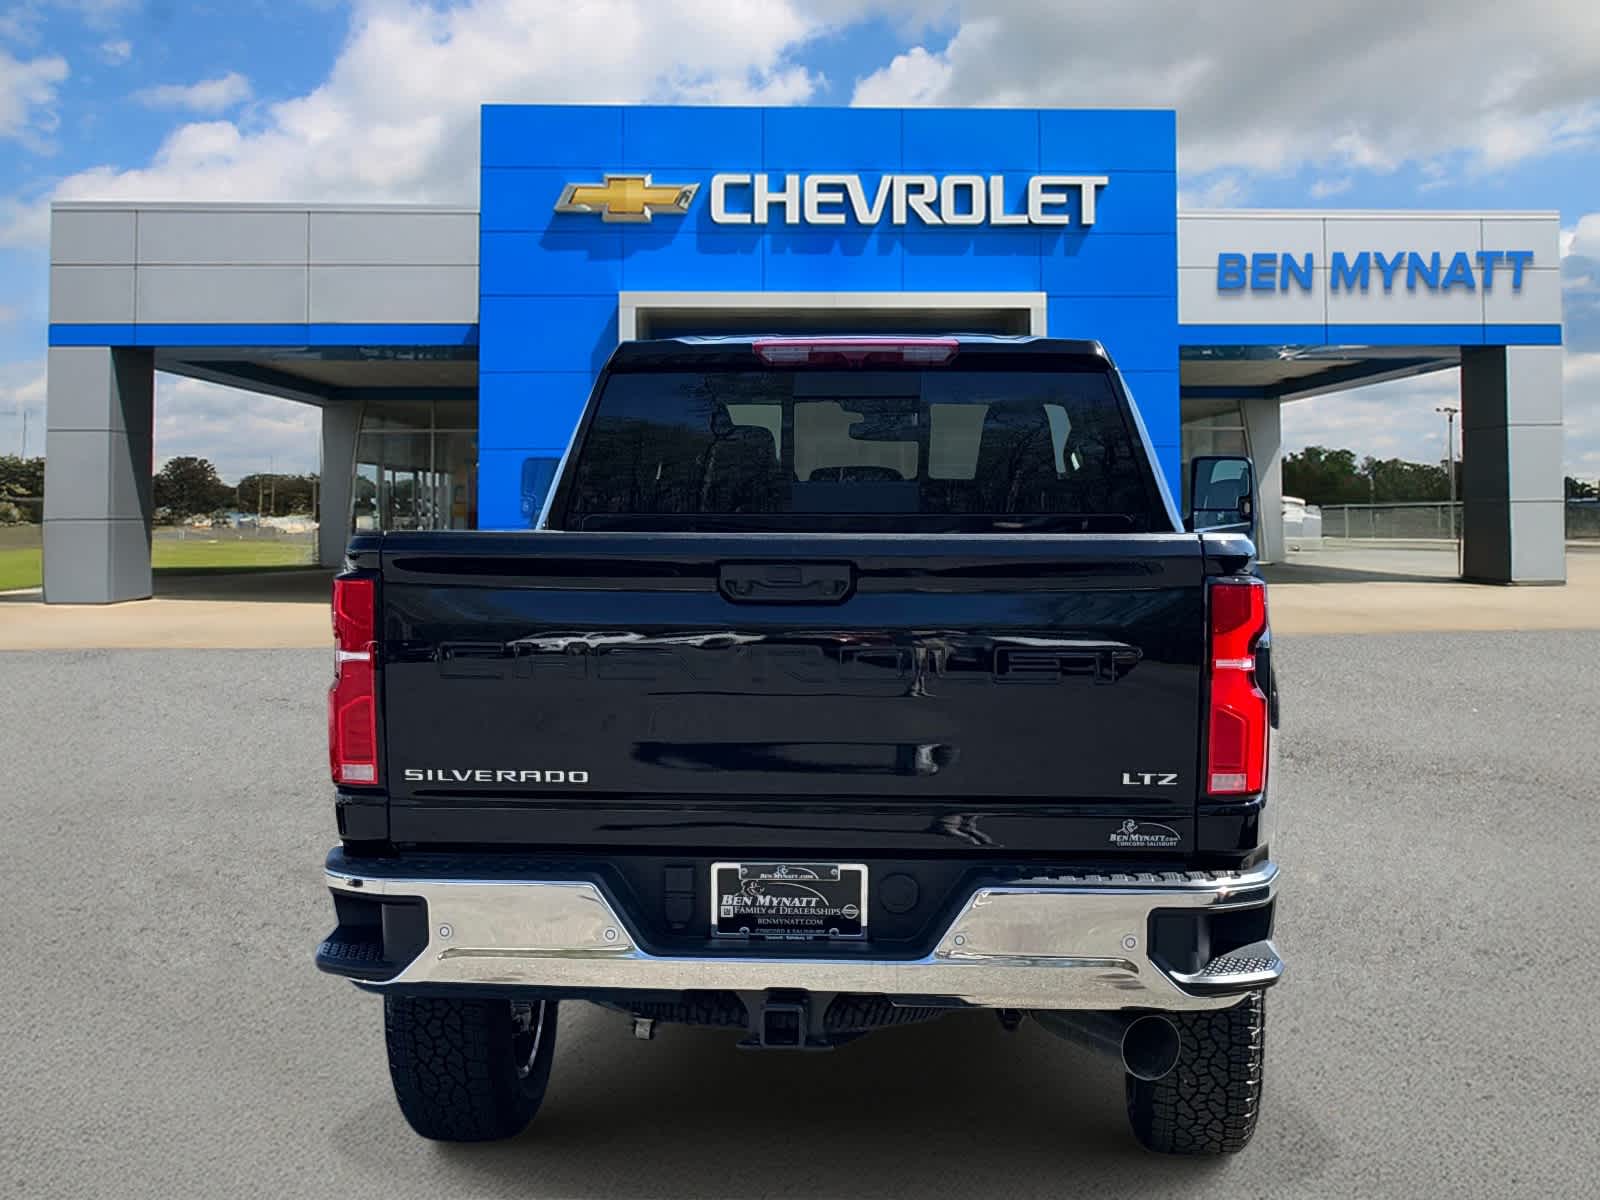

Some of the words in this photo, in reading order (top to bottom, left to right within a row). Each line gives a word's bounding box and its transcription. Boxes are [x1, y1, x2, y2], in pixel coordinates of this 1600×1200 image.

[710, 173, 1109, 225] CHEVROLET
[1216, 252, 1313, 290] BEN
[1330, 250, 1534, 290] MYNATT
[404, 768, 590, 783] SILVERADO
[1122, 772, 1178, 785] LTZ
[721, 894, 753, 906] BEN
[756, 895, 820, 907] MYNATT
[734, 906, 767, 914] FAMILY
[779, 906, 841, 916] DEALERSHIPS
